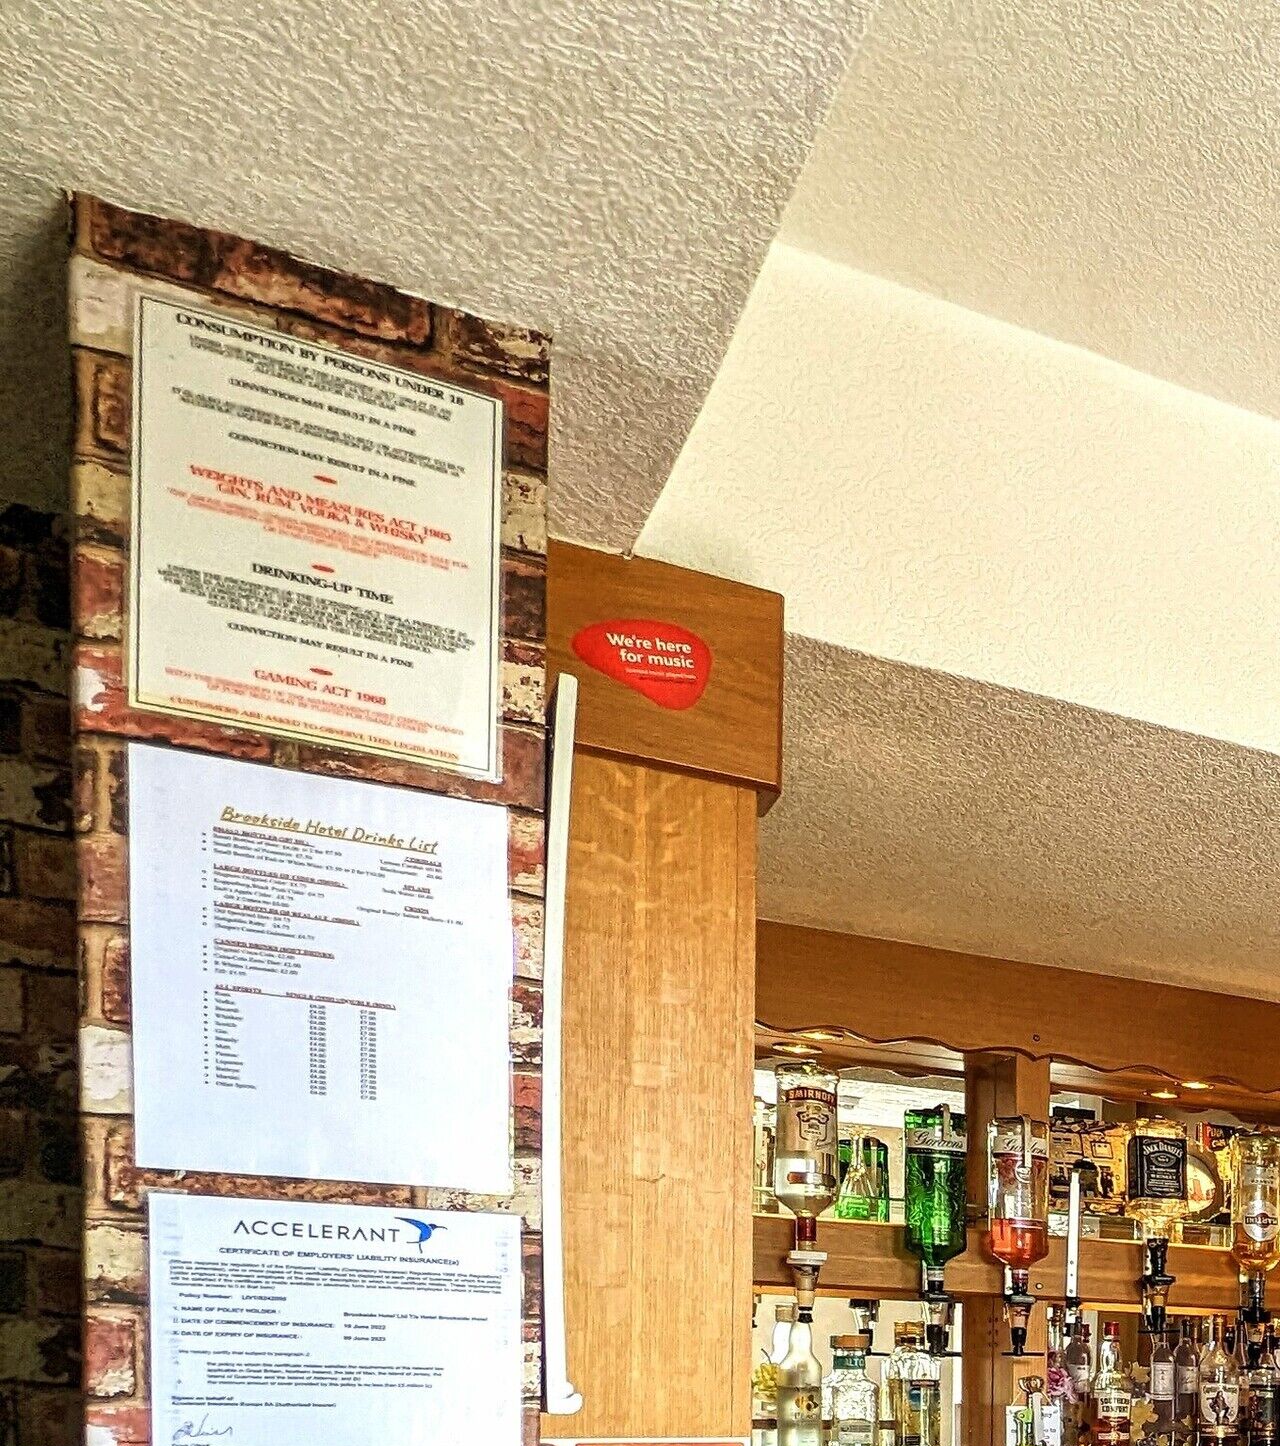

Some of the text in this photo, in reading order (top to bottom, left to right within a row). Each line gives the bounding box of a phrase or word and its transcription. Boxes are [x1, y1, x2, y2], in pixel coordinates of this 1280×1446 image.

[176, 312, 465, 406] CONSUMPTION BY PERSONS UNDER 18
[190, 465, 263, 490] WEIGHTS
[270, 485, 302, 501] AND
[306, 495, 384, 523] MEASURES
[390, 517, 416, 532] ACT
[300, 503, 350, 525] VODKA
[370, 521, 426, 545] WHISKY
[252, 562, 394, 605] DRINKING-UP TIME
[227, 622, 414, 669] CONVICTION MAY RESULT IN A FINE
[606, 632, 692, 654] We're here
[620, 648, 695, 669] for music
[254, 669, 387, 706] GAMING ACT 1968
[221, 806, 300, 830] Brookside
[305, 819, 348, 838] Hotel
[352, 827, 404, 848] Drinks
[409, 836, 438, 854] List
[233, 1219, 400, 1243] ACCELERANT
[219, 1247, 280, 1257] CERTIFICATE
[297, 1250, 354, 1260] EMPLOYERS'
[356, 1254, 397, 1262] LIABILITY
[1101, 1405, 1128, 1413] COMFORT
